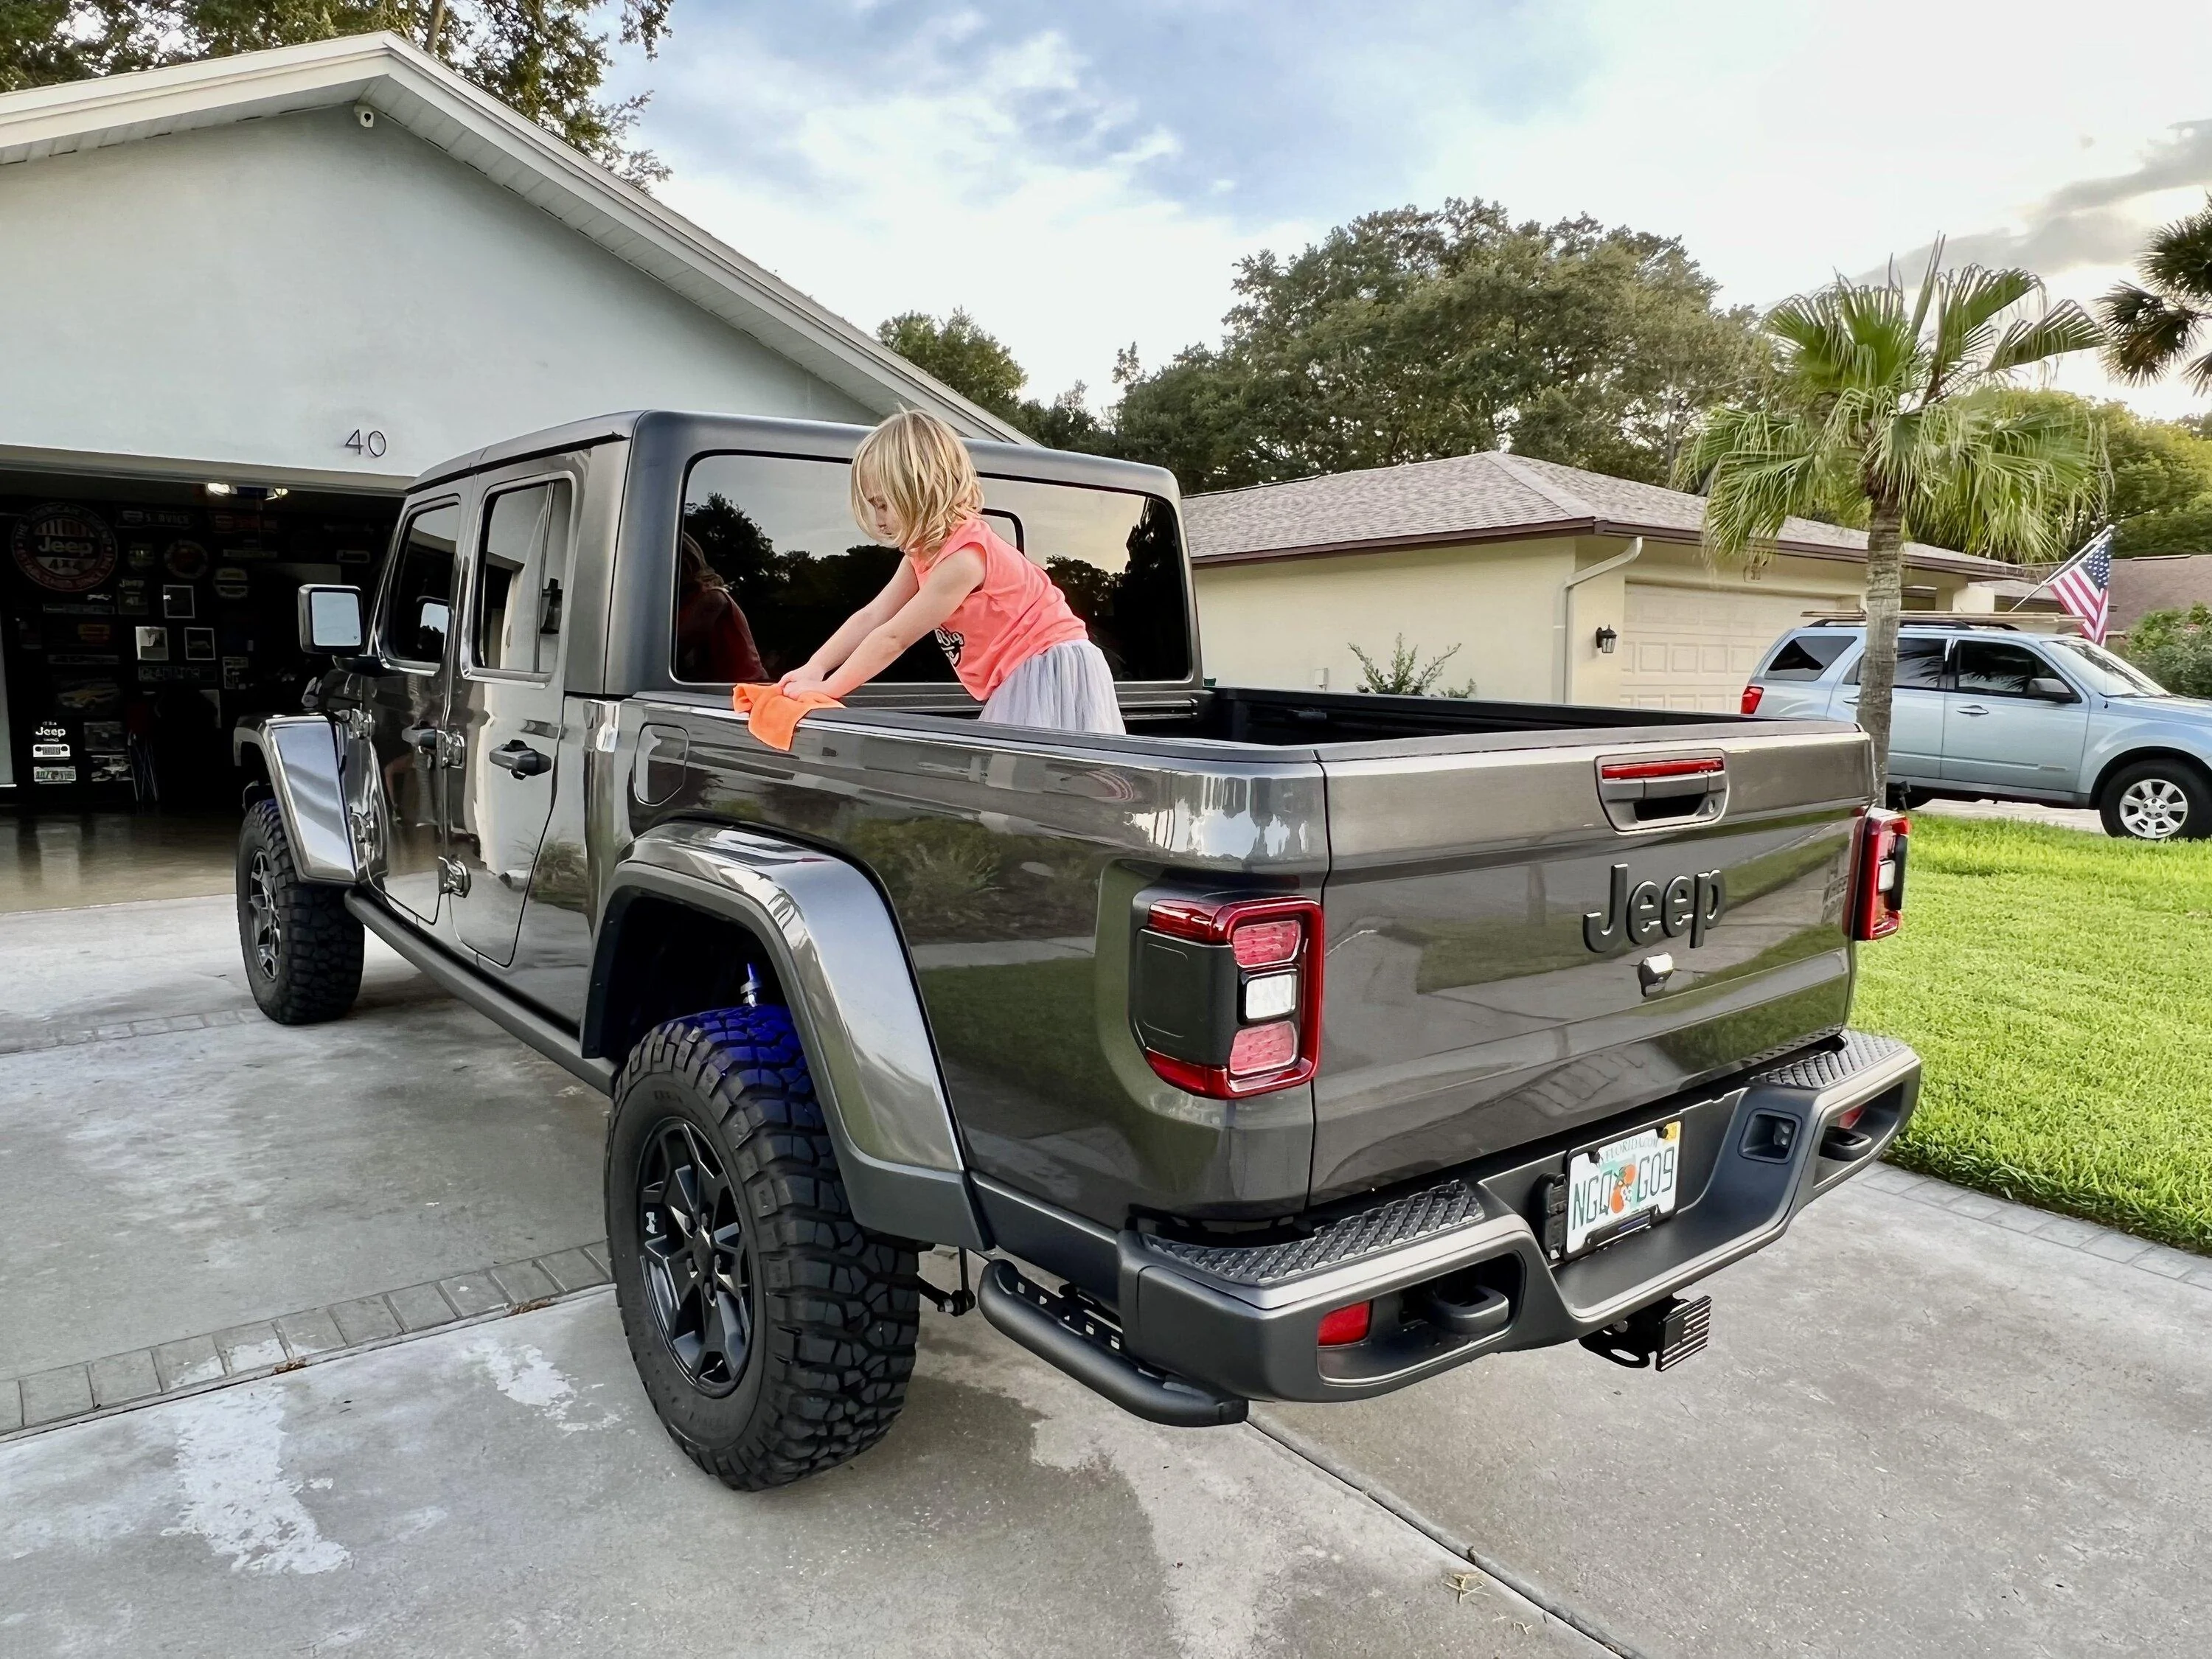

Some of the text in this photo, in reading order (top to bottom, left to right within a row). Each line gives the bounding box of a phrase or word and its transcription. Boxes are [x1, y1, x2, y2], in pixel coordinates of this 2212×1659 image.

[344, 428, 386, 457] 40
[37, 535, 94, 557] Jeep
[935, 628, 964, 646] Big
[35, 726, 66, 737] Jeep
[1582, 863, 1728, 953] Jeep
